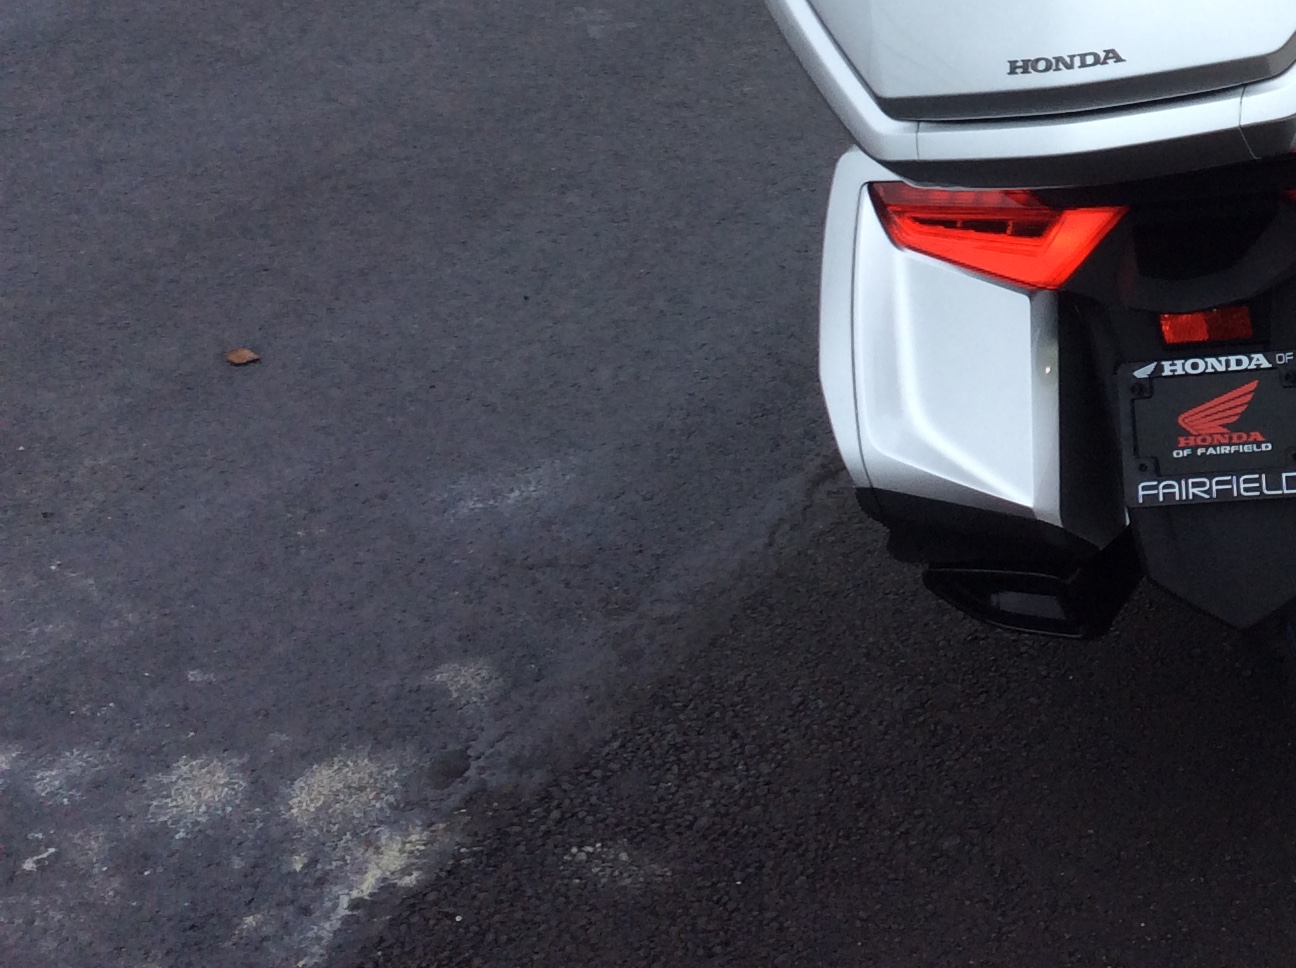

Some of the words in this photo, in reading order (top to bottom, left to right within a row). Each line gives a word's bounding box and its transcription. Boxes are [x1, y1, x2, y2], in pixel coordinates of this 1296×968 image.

[1006, 48, 1127, 76] HONDA
[1161, 353, 1273, 377] HONDA
[1275, 352, 1294, 365] OF
[1177, 431, 1267, 447] HONDA
[1172, 448, 1192, 458] OF
[1197, 443, 1273, 456] FAIRFIELD
